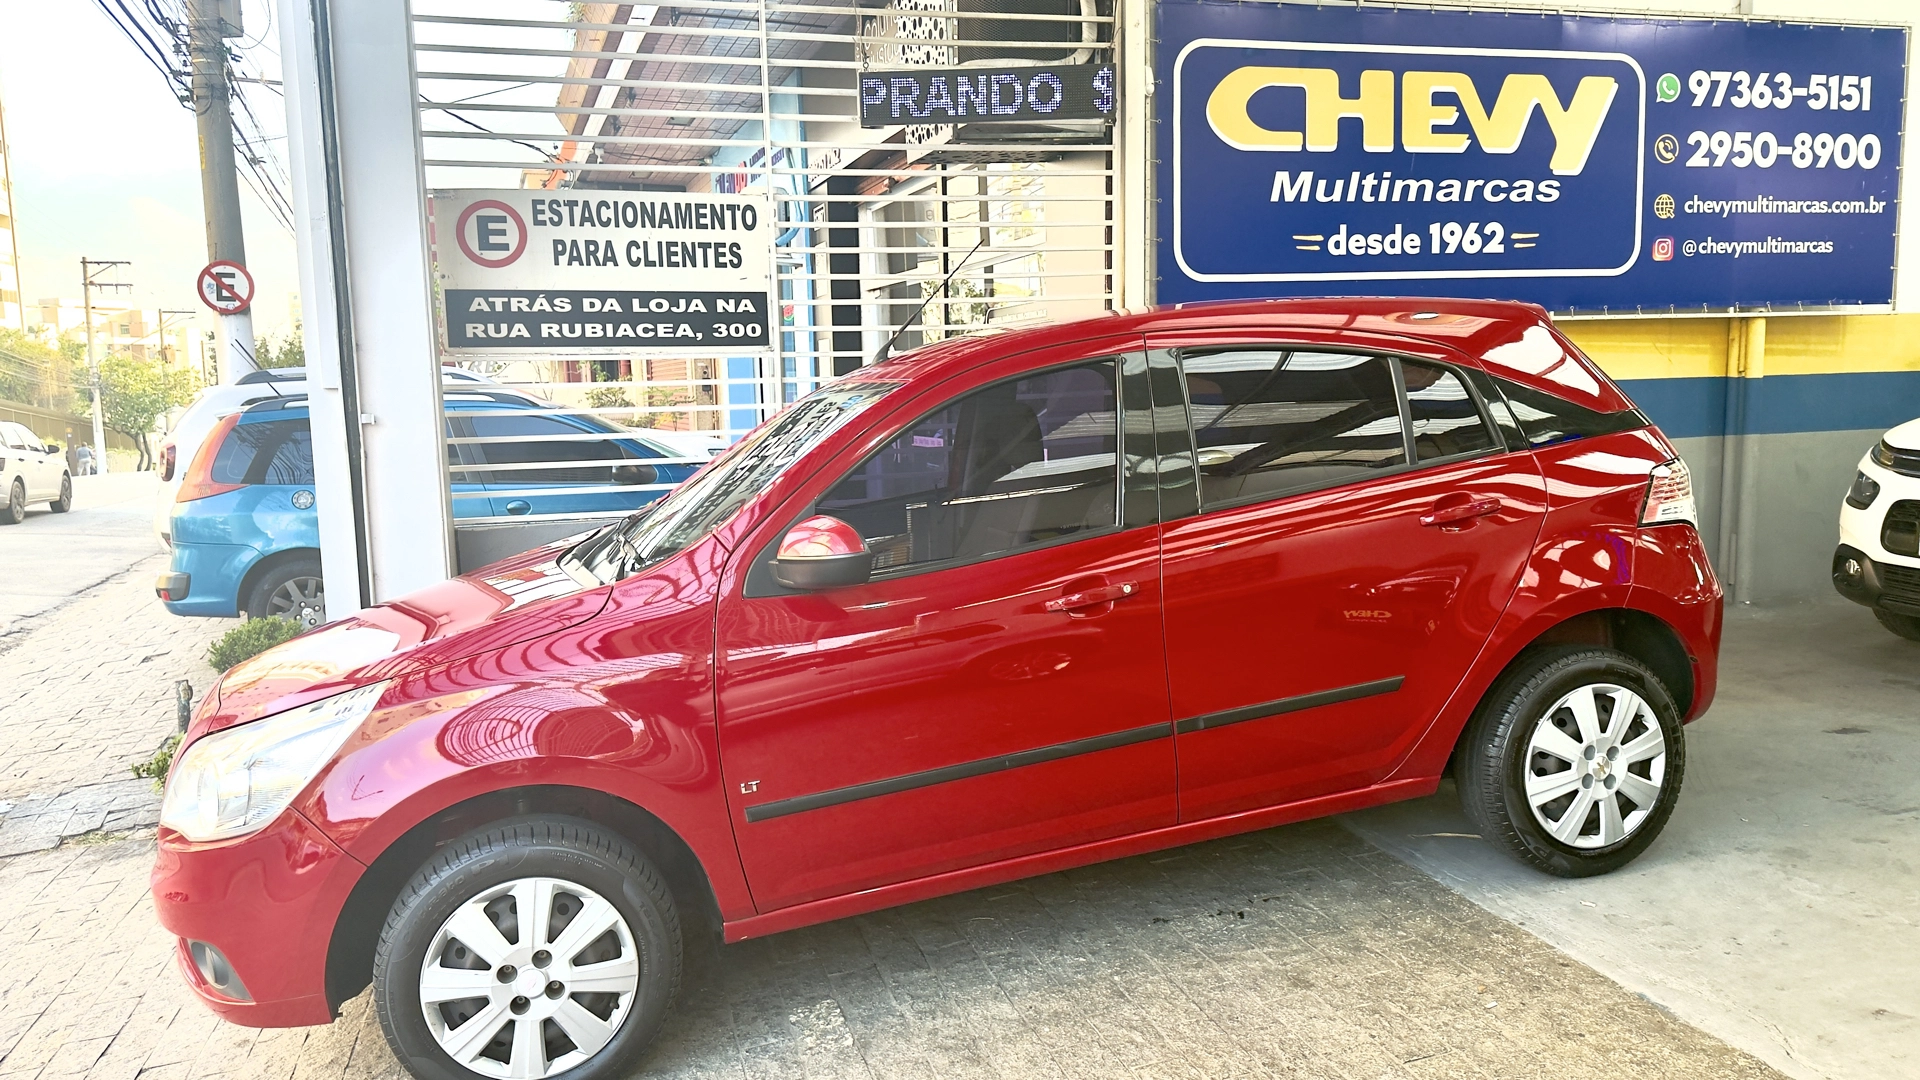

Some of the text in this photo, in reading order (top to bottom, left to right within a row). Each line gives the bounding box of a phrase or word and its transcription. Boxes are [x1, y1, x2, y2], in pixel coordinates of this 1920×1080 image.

[862, 72, 1063, 118] PRANDO
[1688, 70, 1872, 111] 97363-5151
[1206, 65, 1619, 176] CHEVY
[1685, 130, 1882, 169] 2950-8900
[1269, 170, 1562, 204] Multimarcas
[531, 198, 758, 231] ESTACIONAMENTO
[1684, 195, 1886, 218] chevymultimarcas.com.br
[476, 215, 510, 251] E
[1327, 222, 1505, 256] desde 1962
[1682, 236, 1834, 258] @chevymultimarcas
[552, 238, 743, 269] PARA CLIENTES
[468, 294, 757, 313] ATRÁS DA LOJA NA
[464, 322, 762, 341] RUA RUBIACEA, 300
[740, 780, 761, 795] LT
